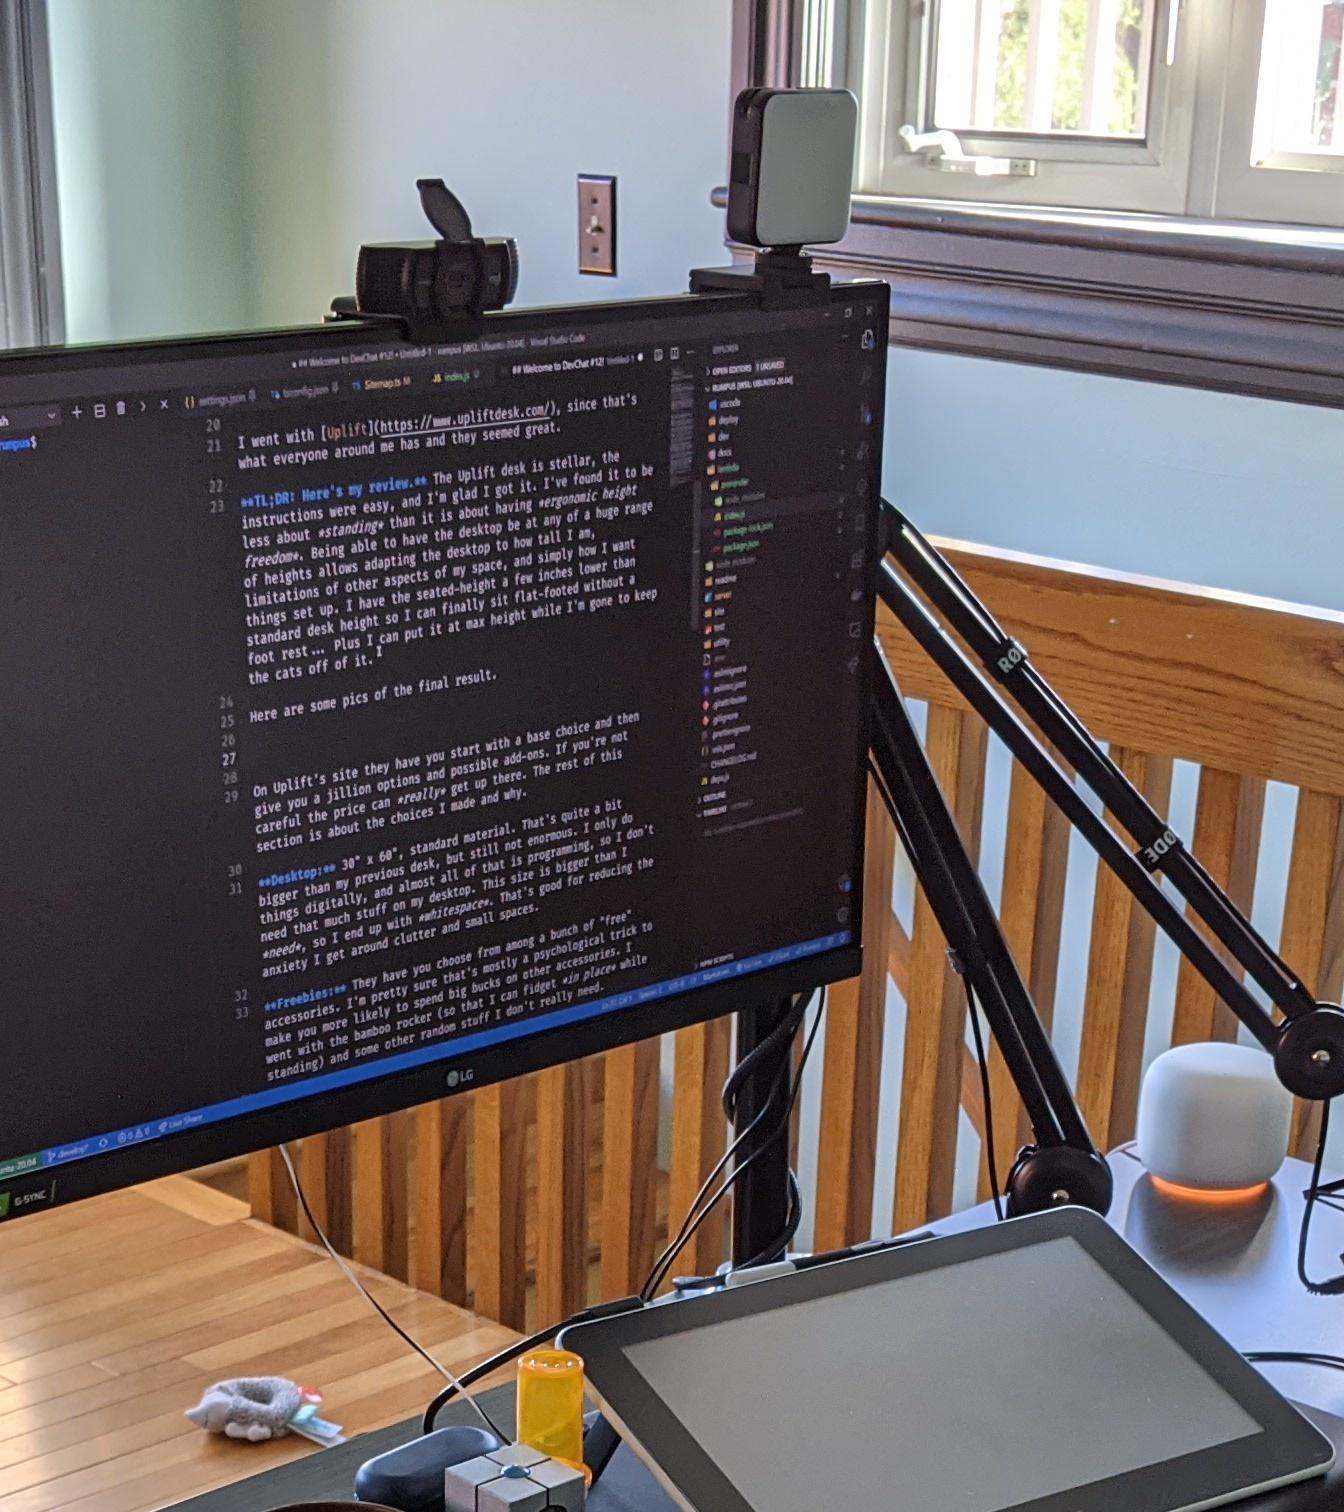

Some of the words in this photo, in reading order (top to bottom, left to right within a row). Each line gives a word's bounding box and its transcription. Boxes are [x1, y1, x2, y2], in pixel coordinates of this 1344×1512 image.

[523, 362, 553, 374] Welcome
[562, 358, 589, 370] DevChat
[238, 454, 266, 469] what
[274, 449, 328, 465] everyone
[335, 441, 374, 458] around
[380, 435, 397, 452] me
[398, 433, 423, 450] has
[423, 430, 448, 447] and
[449, 426, 479, 445] they
[480, 422, 522, 440] seemed
[523, 419, 560, 439] great.
[251, 433, 279, 447] went
[286, 428, 314, 443] with
[568, 398, 597, 412] since
[603, 393, 637, 408] that's
[242, 508, 323, 529] instructions
[329, 505, 356, 517] were
[363, 501, 394, 513] easy,
[402, 493, 421, 508] and
[428, 491, 446, 505] I'm
[452, 486, 477, 504] glad
[495, 482, 513, 498] got
[521, 479, 536, 493] it.
[544, 476, 567, 489] I've
[574, 470, 602, 485] found
[609, 468, 619, 481] it
[625, 467, 636, 478] to
[642, 464, 653, 476] be
[246, 611, 286, 627] things
[294, 606, 313, 620] set
[320, 605, 338, 617] up.
[359, 597, 385, 609] have
[392, 591, 410, 604] the
[417, 578, 496, 600] seated-height
[515, 573, 533, 585] few
[539, 567, 573, 582] inches
[579, 562, 607, 575] lower
[613, 557, 635, 570] than
[249, 671, 269, 685] the
[276, 666, 302, 680] cats
[309, 659, 328, 674] off
[335, 656, 347, 670] of
[355, 654, 372, 667] it.
[997, 648, 1022, 673] RØ
[250, 709, 277, 722] Here
[284, 704, 304, 716] are
[310, 699, 336, 712] some
[343, 692, 368, 709] pics
[374, 686, 387, 700] of
[394, 684, 412, 697] the
[419, 676, 448, 692] final
[456, 669, 496, 686] result.
[223, 753, 236, 766] 27
[253, 785, 267, 797] On
[273, 773, 326, 795] Uplift's
[333, 768, 358, 782] site
[365, 763, 389, 775] they
[395, 756, 420, 769] have
[426, 752, 444, 766] you
[451, 743, 480, 759] start
[486, 737, 510, 751] with
[527, 730, 550, 743] base
[556, 722, 590, 737] choice
[595, 715, 612, 729] and
[617, 713, 639, 725] then
[257, 835, 302, 852] section
[310, 829, 322, 842] is
[328, 822, 360, 837] about
[366, 817, 385, 829] the
[391, 807, 433, 824] choices
[451, 797, 475, 811] made
[481, 790, 499, 805] and
[504, 788, 526, 800] why.
[1144, 830, 1177, 863] ØDE
[259, 890, 298, 907] bigger
[305, 883, 330, 896] than
[336, 879, 349, 891] my
[355, 866, 404, 888] previous
[411, 857, 439, 872] desk,
[447, 852, 464, 864] but
[471, 842, 498, 859] still
[505, 839, 522, 851] not
[528, 828, 577, 846] enormous.
[594, 816, 617, 830] only
[622, 813, 633, 824] do
[263, 959, 308, 977] anxiety
[327, 949, 345, 965] get
[351, 937, 388, 956] around
[394, 928, 436, 945] clutter
[442, 919, 460, 934] and
[465, 912, 494, 928] small
[500, 904, 539, 920] spaces.
[268, 1056, 323, 1081] standing)
[331, 1049, 348, 1064] and
[355, 1044, 379, 1057] some
[385, 1034, 415, 1049] other
[421, 1023, 456, 1040] random
[462, 1011, 490, 1028] stuff
[506, 1001, 533, 1016] don't
[540, 991, 572, 1007] really
[578, 981, 604, 996] need.
[460, 1069, 473, 1082] LG
[14, 1190, 46, 1206] G-SYNC
